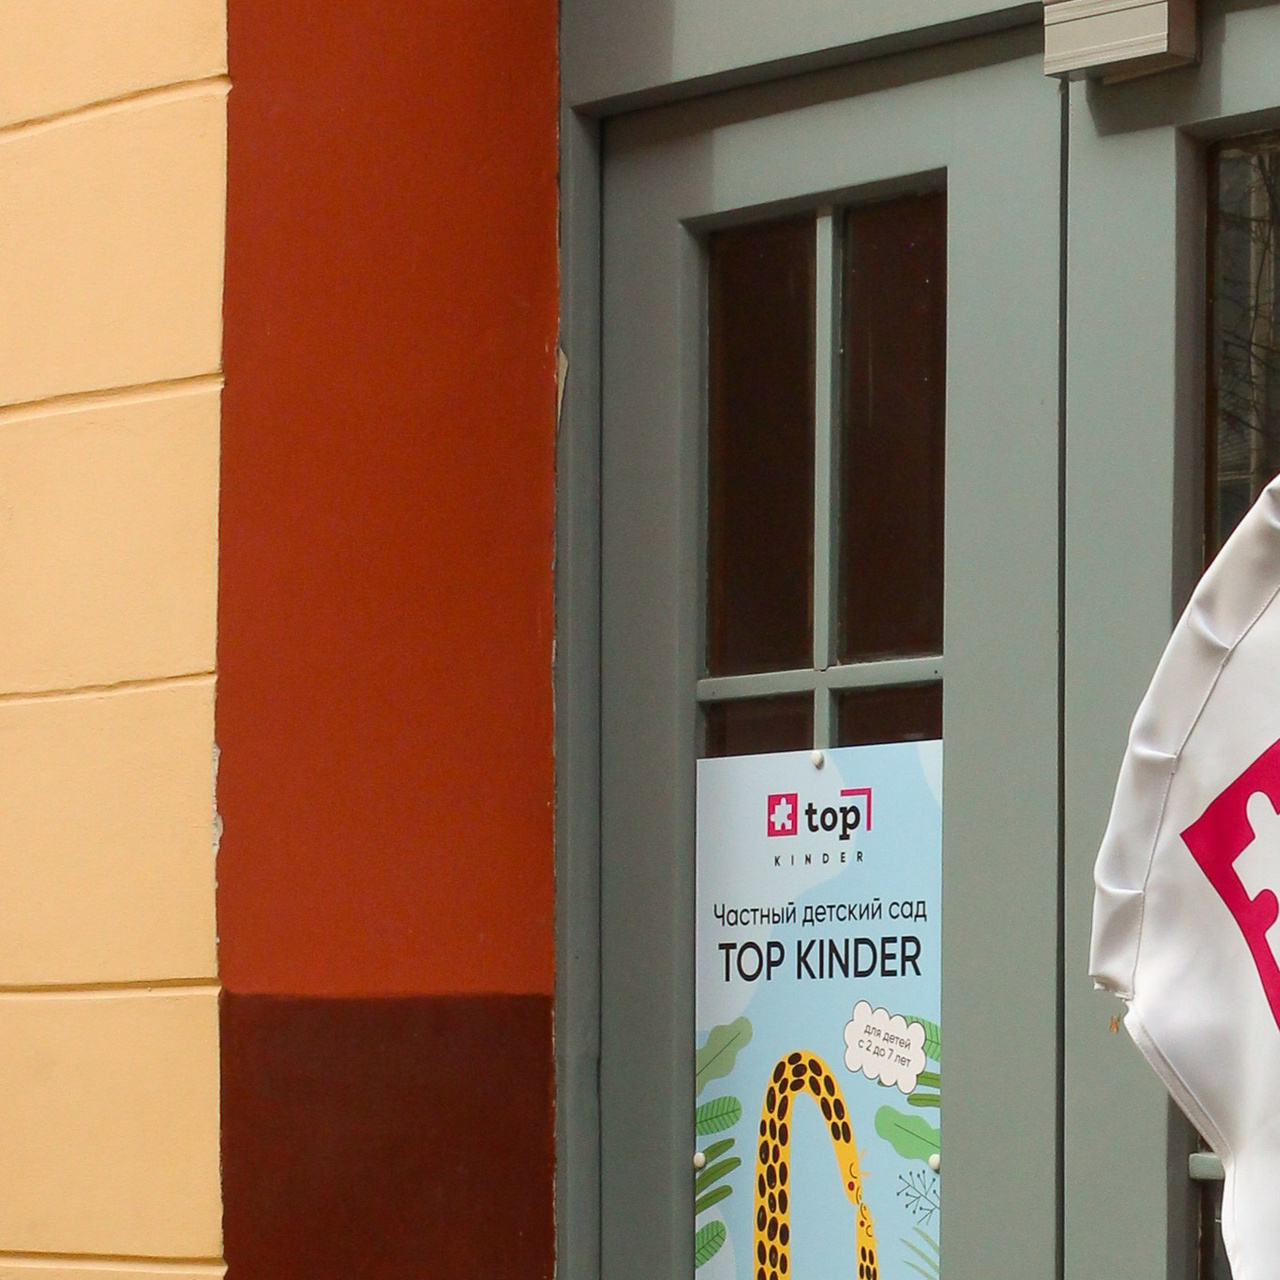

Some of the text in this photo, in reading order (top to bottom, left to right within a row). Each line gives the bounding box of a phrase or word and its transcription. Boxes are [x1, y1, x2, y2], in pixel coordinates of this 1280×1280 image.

[805, 802, 861, 840] top
[774, 851, 864, 866] KINDER
[713, 898, 927, 927] Частный детский сад
[718, 935, 922, 982] TOP KINDER
[863, 1024, 911, 1050] для детей
[858, 1039, 912, 1068] с 2 до 7 лет
